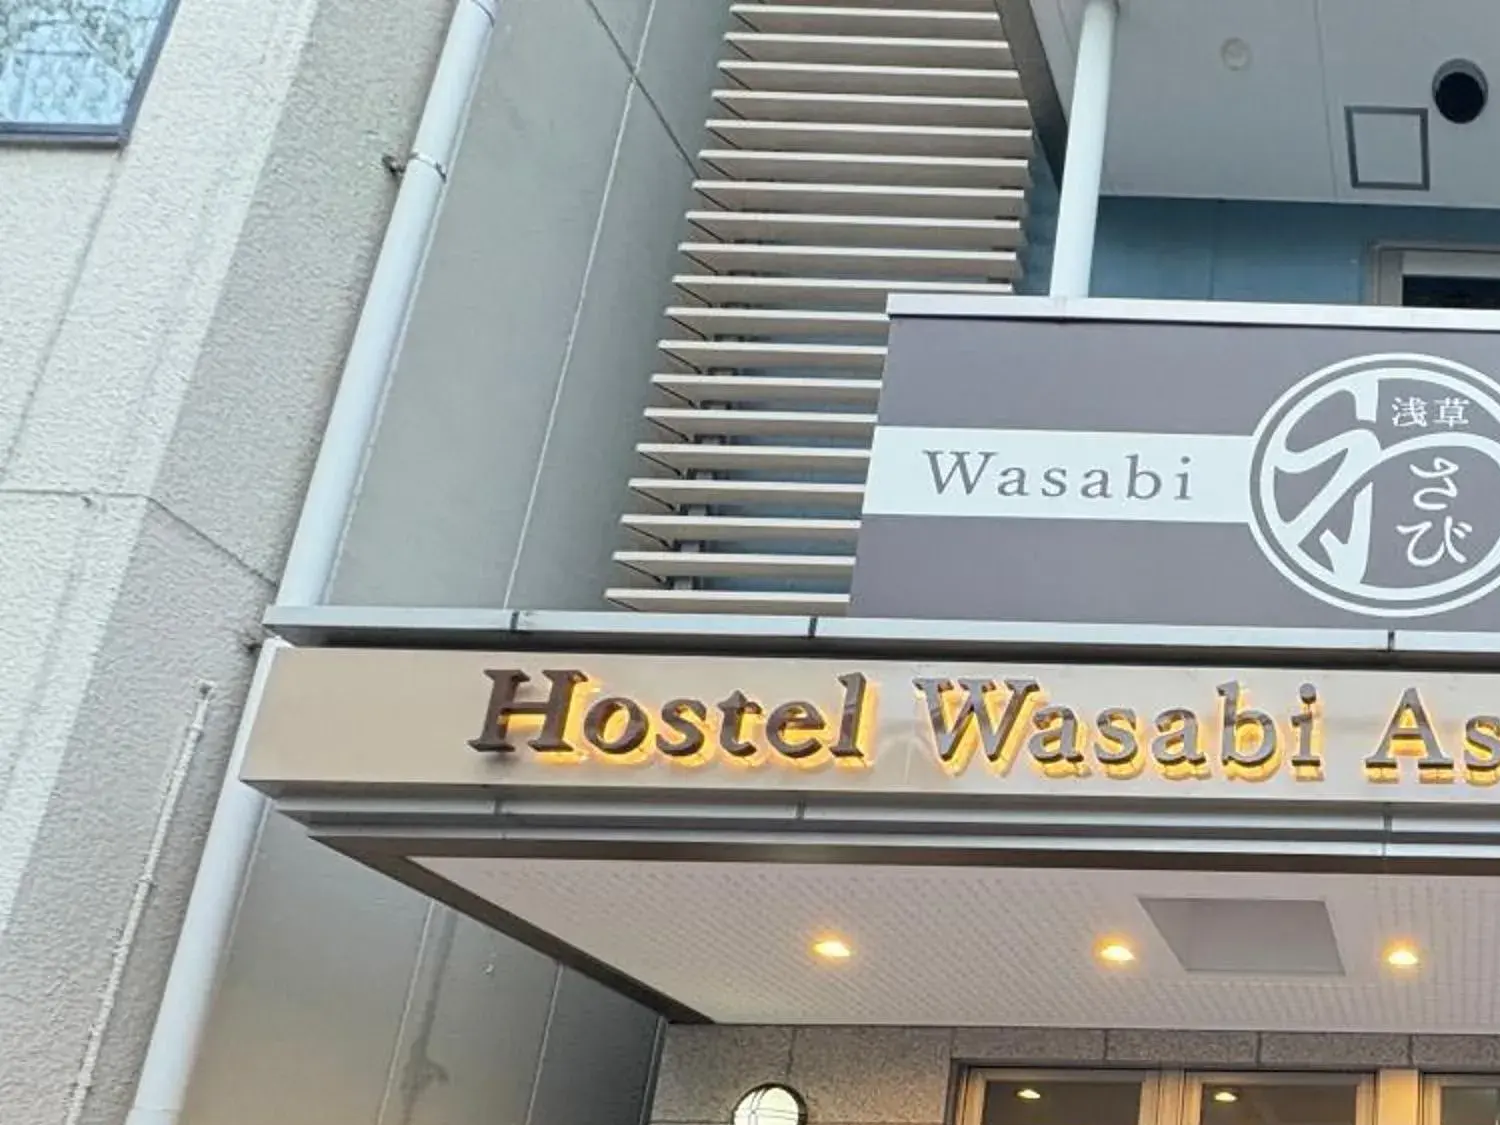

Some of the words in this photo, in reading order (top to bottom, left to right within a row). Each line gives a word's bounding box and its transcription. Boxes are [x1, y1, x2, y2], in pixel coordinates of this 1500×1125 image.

[1392, 396, 1469, 428] 浅草
[923, 448, 1195, 502] Wasabi
[467, 668, 870, 760] Hostel
[913, 677, 1322, 770] Wasabi
